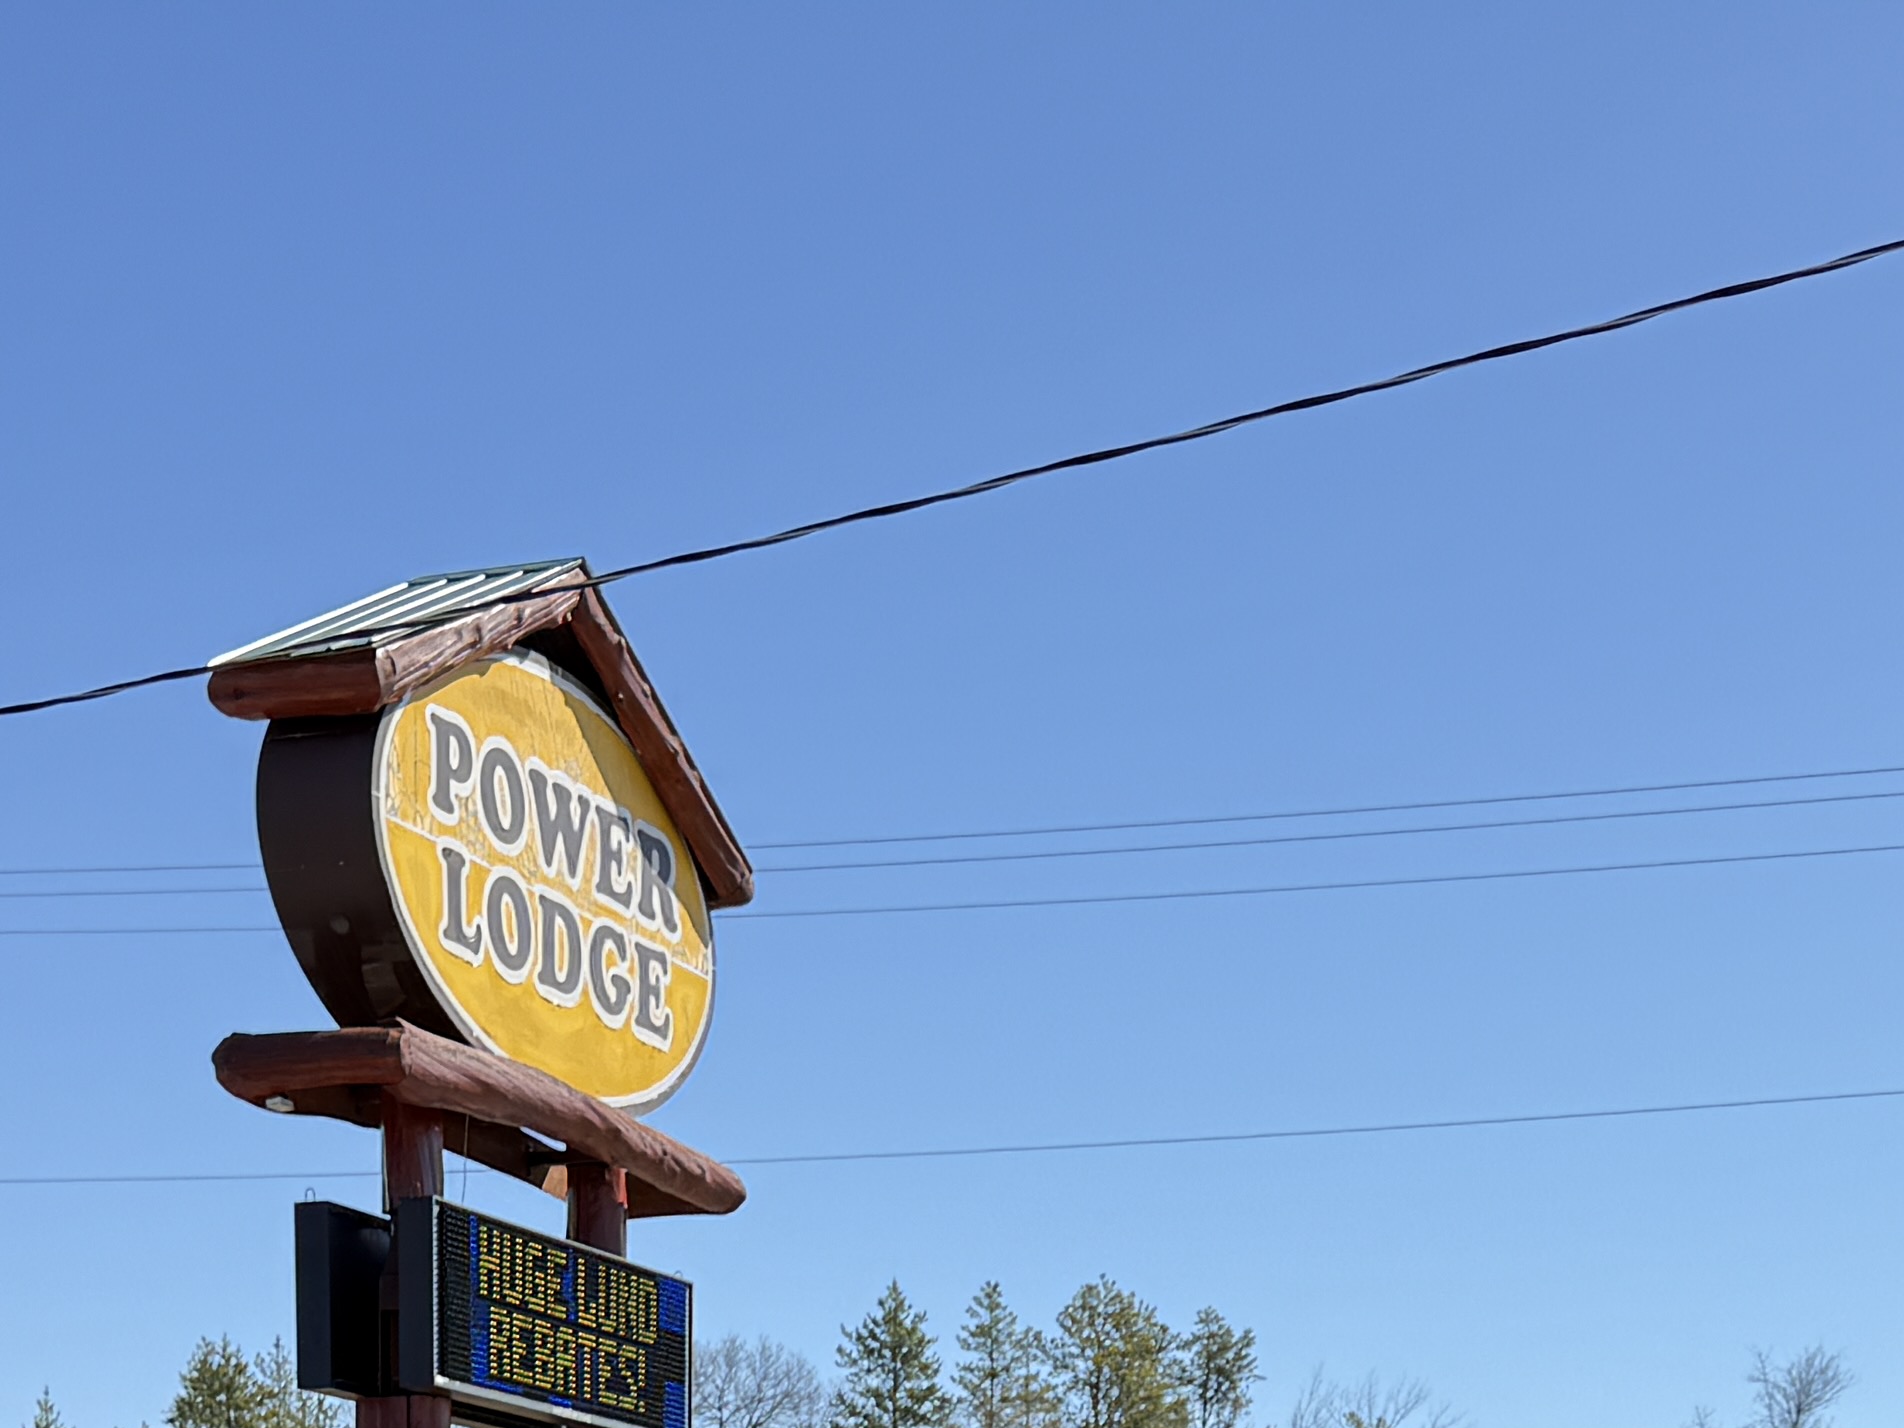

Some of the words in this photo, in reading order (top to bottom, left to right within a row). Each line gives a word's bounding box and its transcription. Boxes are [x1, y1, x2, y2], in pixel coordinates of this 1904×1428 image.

[425, 703, 681, 942] POWER
[437, 840, 674, 1053] LODGE
[478, 1225, 568, 1320] HUGE
[576, 1257, 660, 1346] LUND
[489, 1305, 648, 1413] REBATES!
